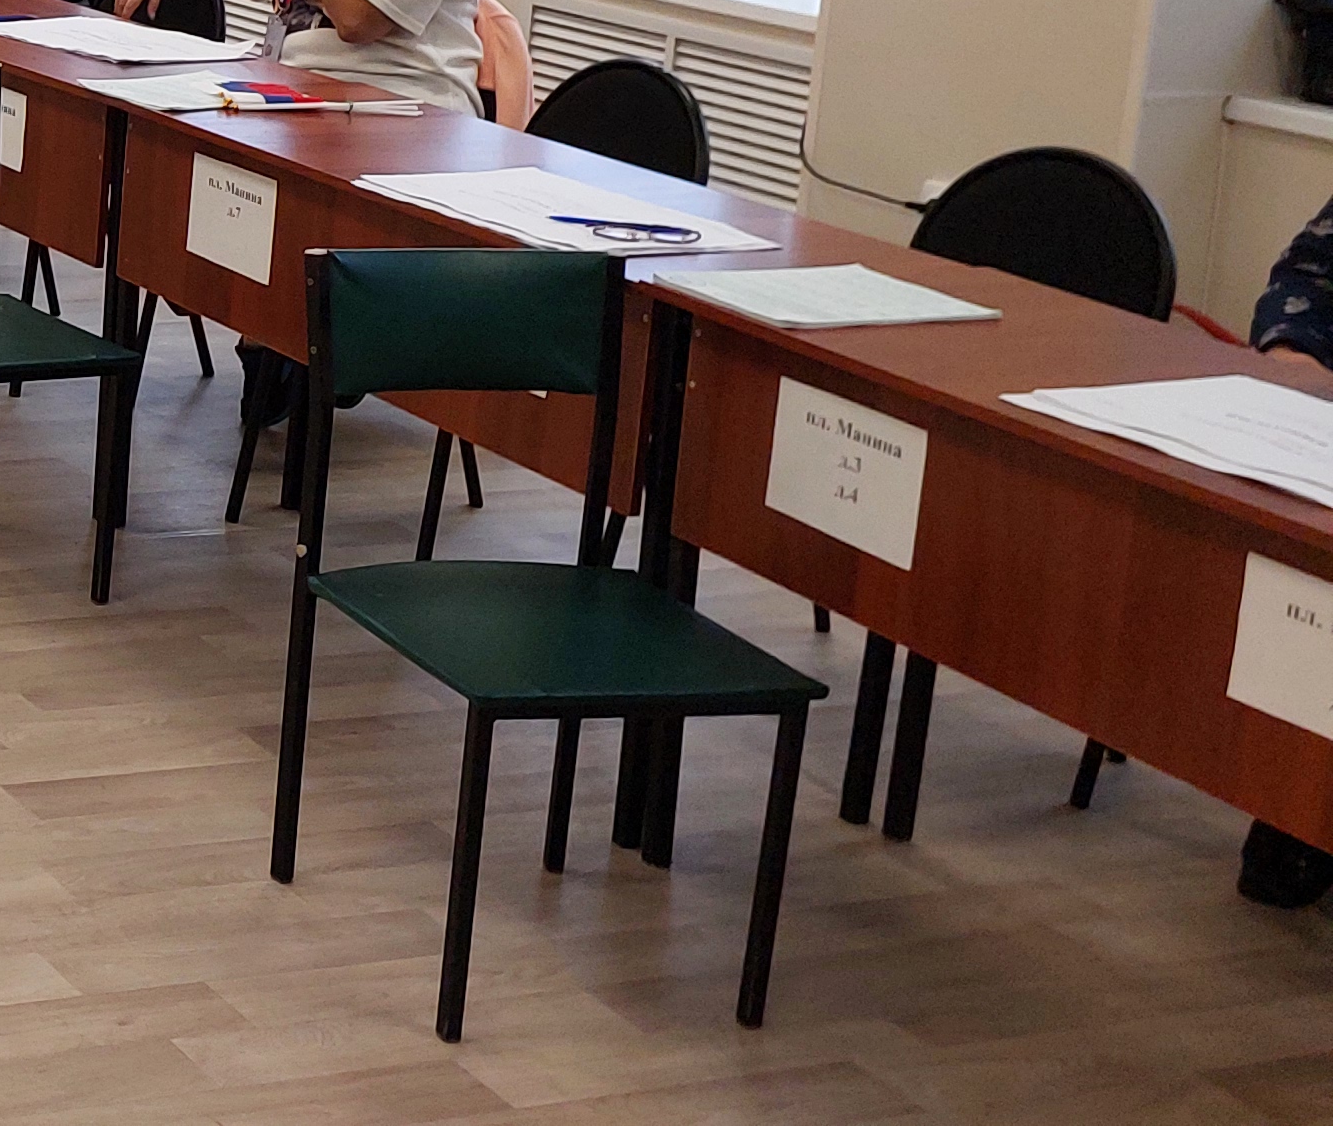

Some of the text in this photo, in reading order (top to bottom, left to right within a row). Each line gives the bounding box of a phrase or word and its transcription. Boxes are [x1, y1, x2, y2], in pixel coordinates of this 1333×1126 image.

[208, 177, 262, 205] пл. Манина
[226, 206, 241, 219] д.7
[806, 411, 902, 459] пл. Манина
[1286, 603, 1323, 629] пл.
